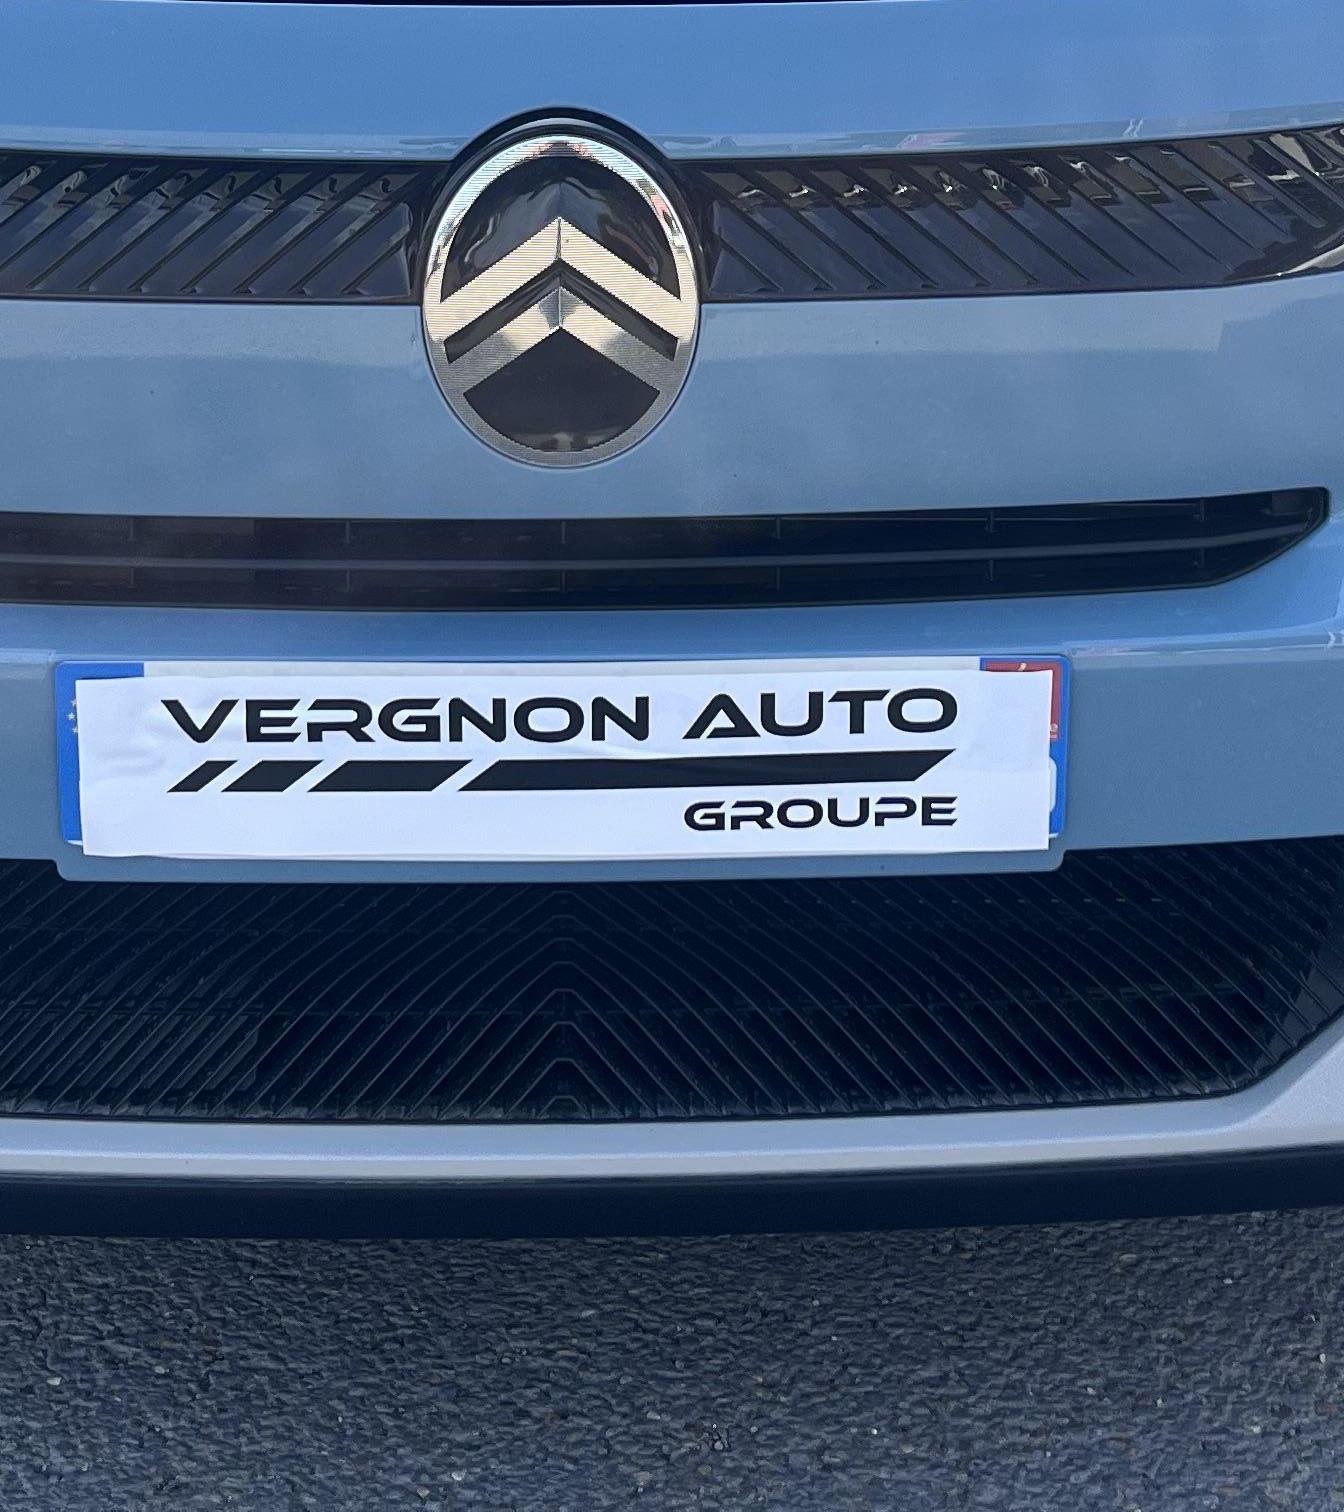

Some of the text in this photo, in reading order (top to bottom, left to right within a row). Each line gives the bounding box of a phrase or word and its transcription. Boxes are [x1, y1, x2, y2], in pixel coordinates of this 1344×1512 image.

[160, 687, 958, 745] VERGNON AUTO
[683, 795, 958, 832] GROUPE
